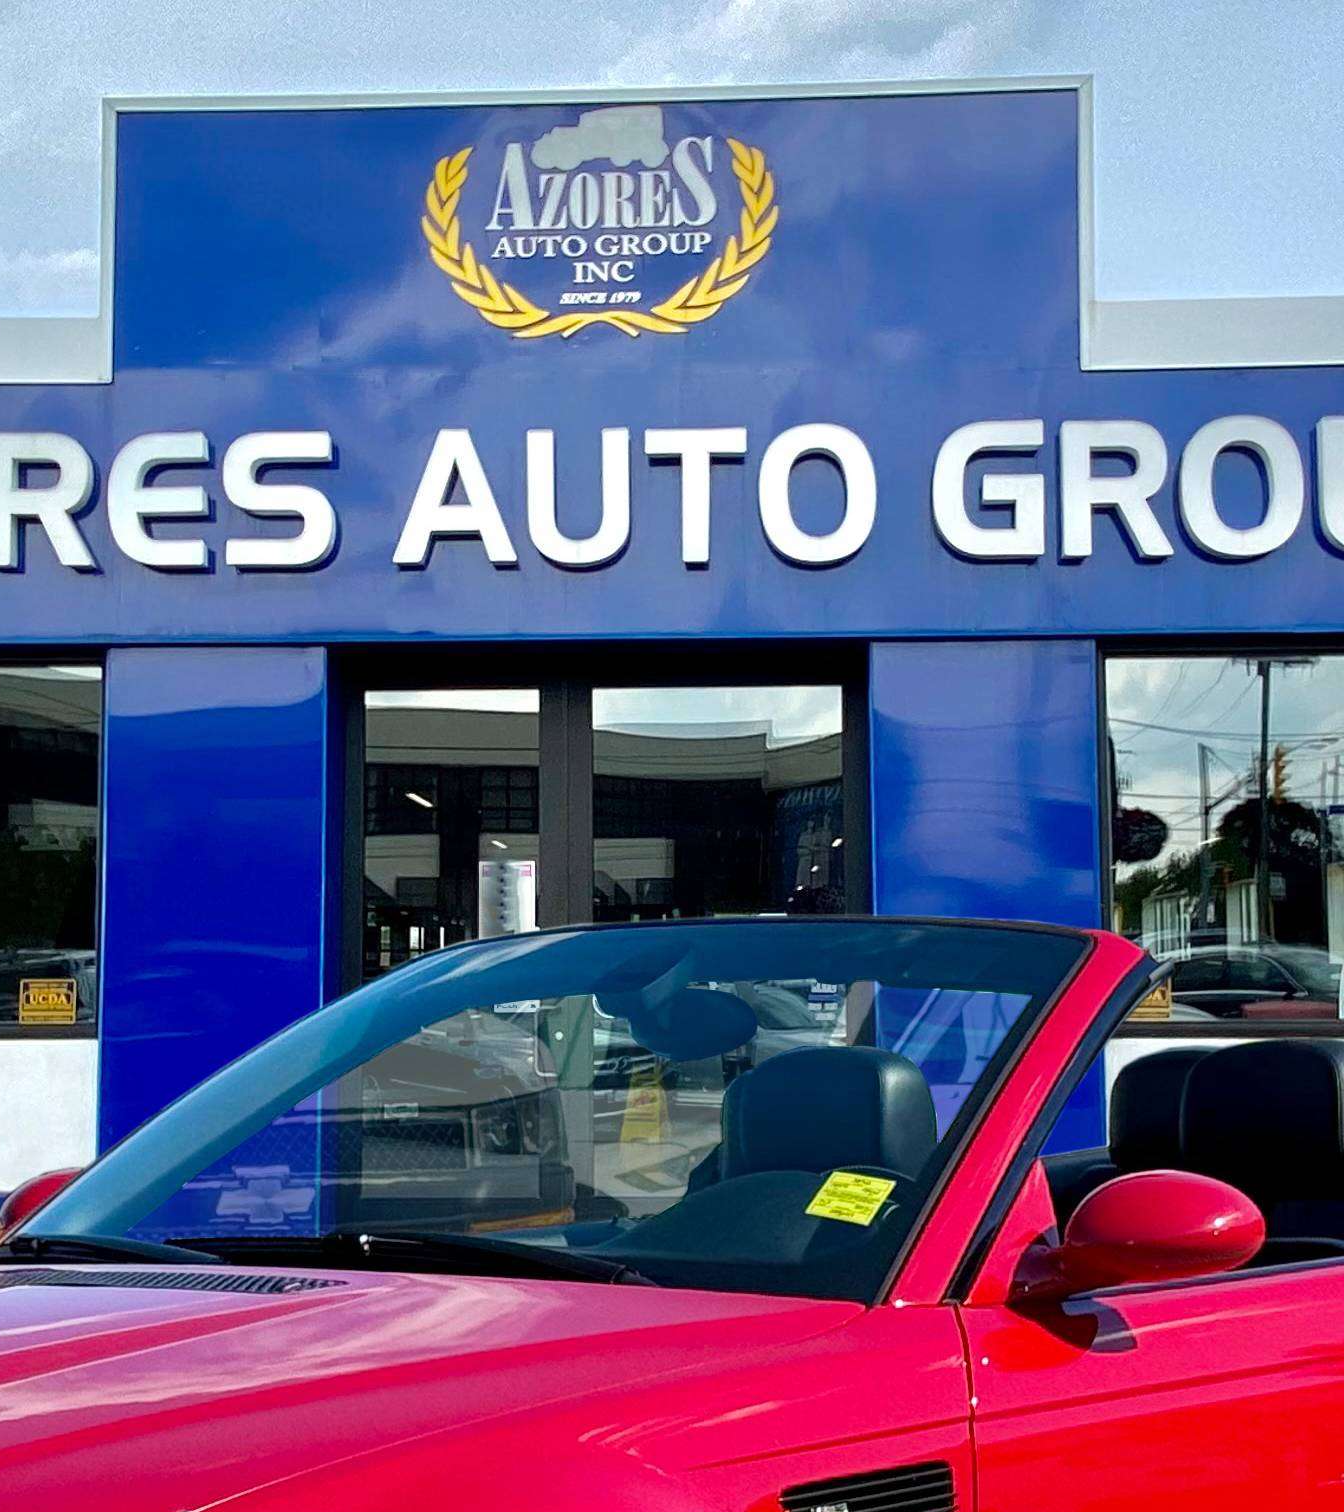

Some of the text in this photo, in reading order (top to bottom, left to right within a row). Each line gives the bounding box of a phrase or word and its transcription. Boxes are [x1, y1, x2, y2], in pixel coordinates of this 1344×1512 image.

[485, 136, 717, 232] AZORES
[491, 232, 712, 259] AUTO GROUP
[572, 262, 635, 284] INC
[559, 291, 642, 305] SINCE 1979
[393, 423, 877, 566] AUTO
[29, 993, 67, 1005] UCDA
